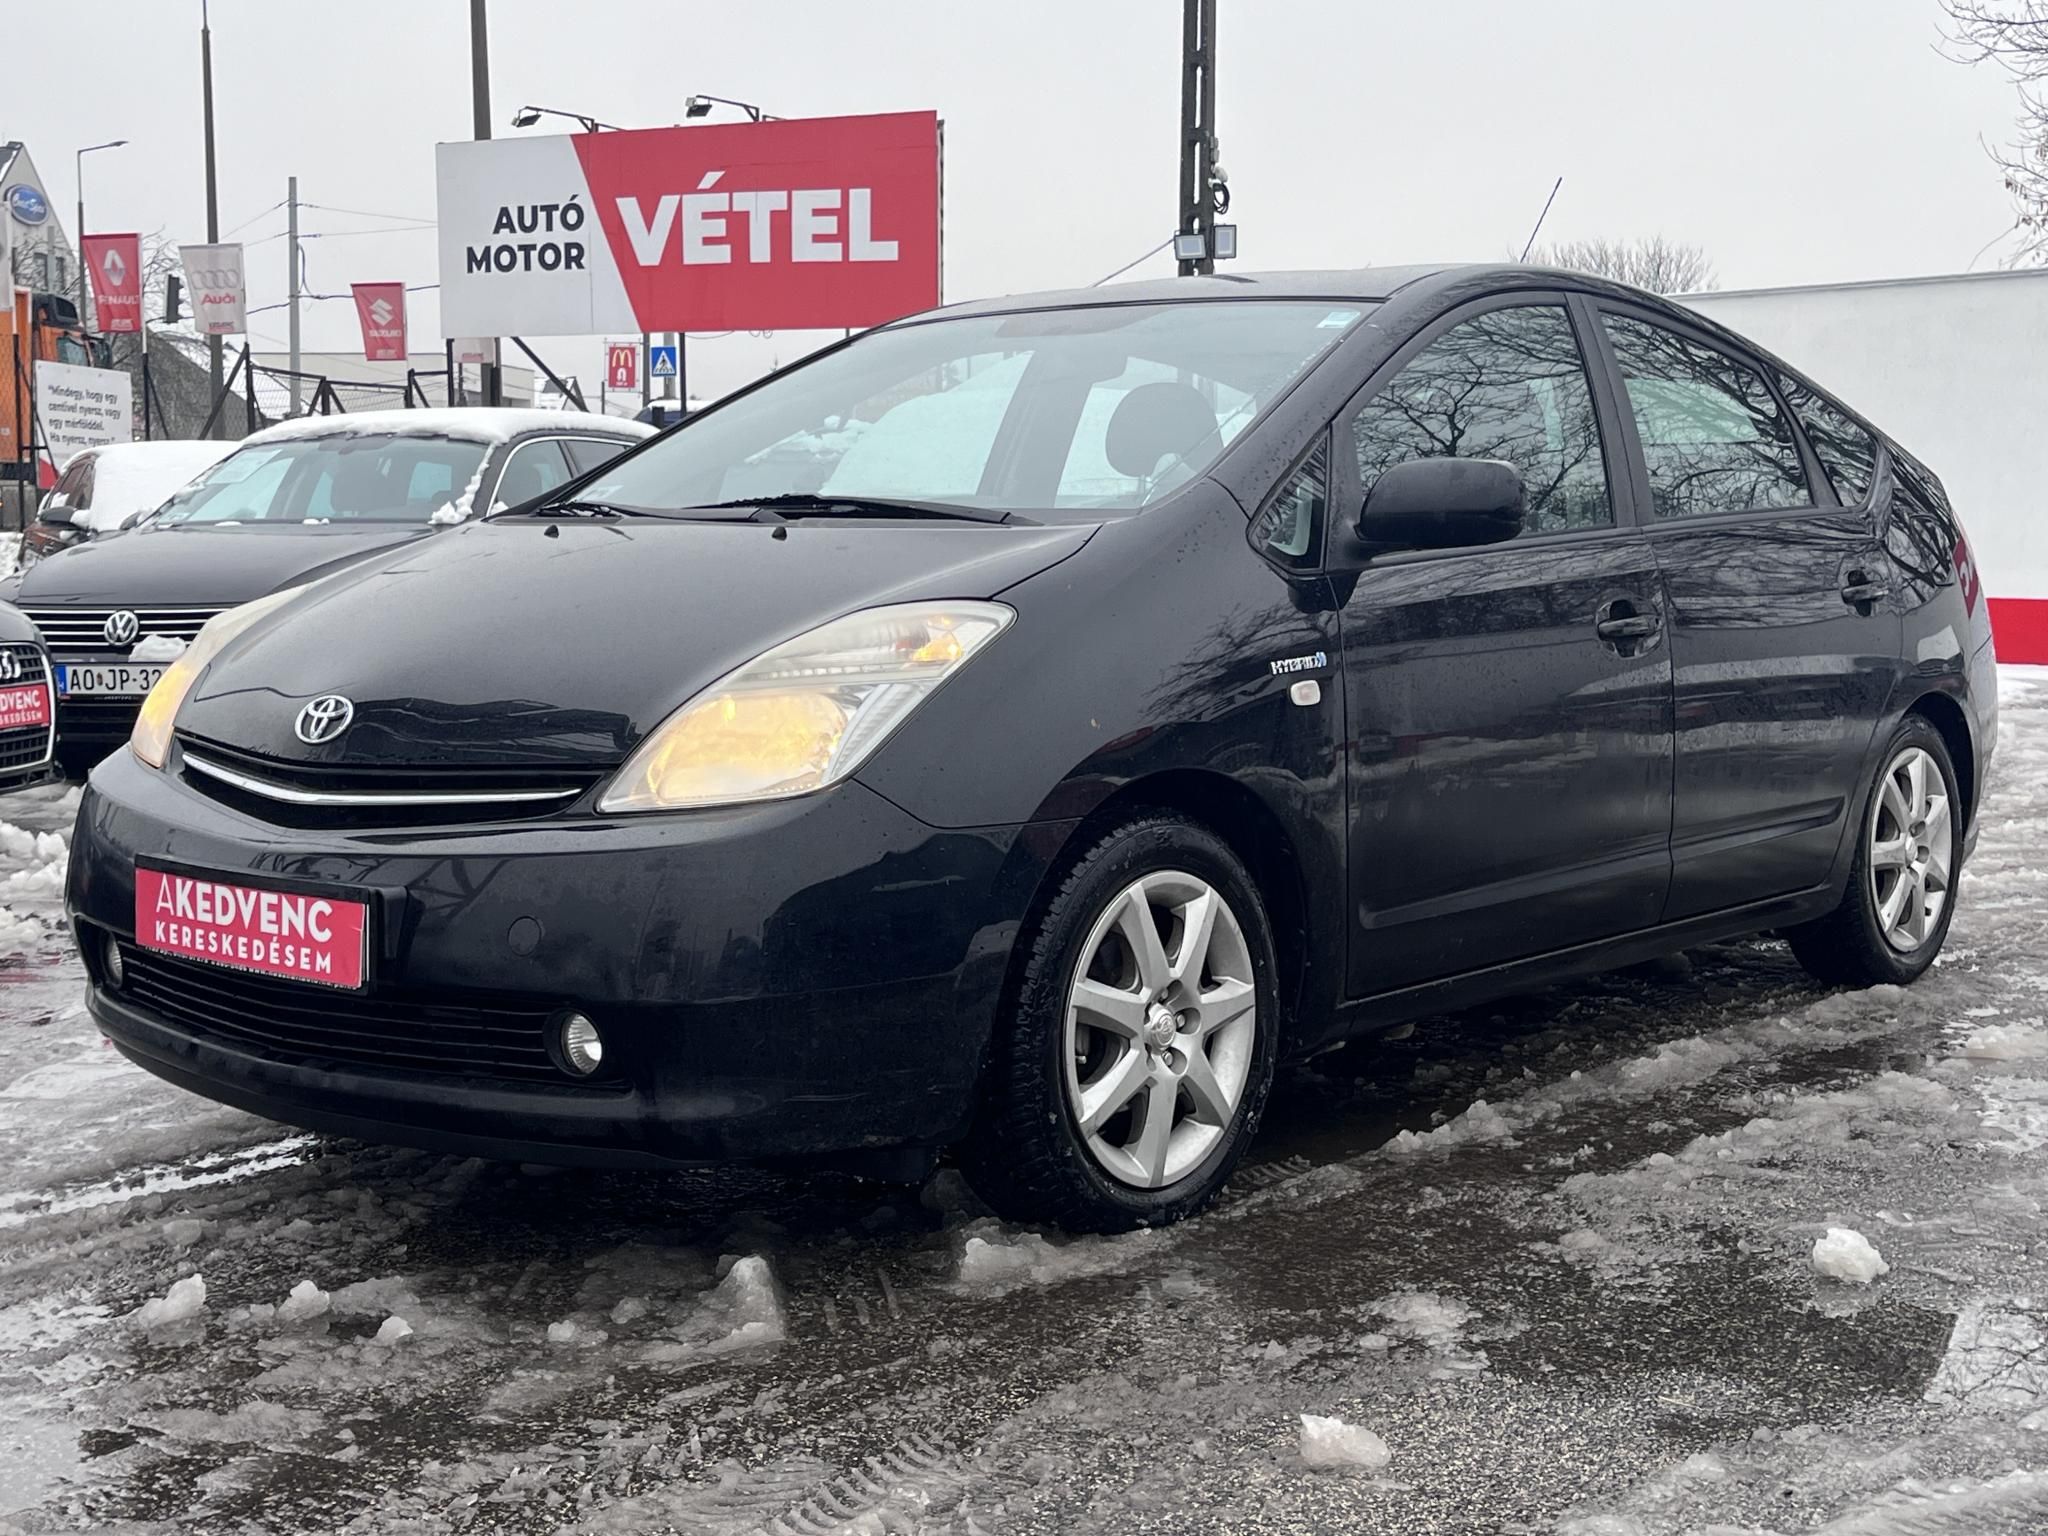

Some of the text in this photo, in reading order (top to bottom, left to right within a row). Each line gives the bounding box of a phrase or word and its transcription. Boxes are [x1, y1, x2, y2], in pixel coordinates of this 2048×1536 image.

[493, 195, 585, 234] AUTÓ
[615, 171, 899, 267] VÉTEL
[466, 242, 586, 274] MOTOR
[201, 293, 236, 305] Audi
[70, 669, 95, 691] AO
[1271, 655, 1318, 675] HYBRID
[155, 920, 332, 974] KERESKEDÉSEM
